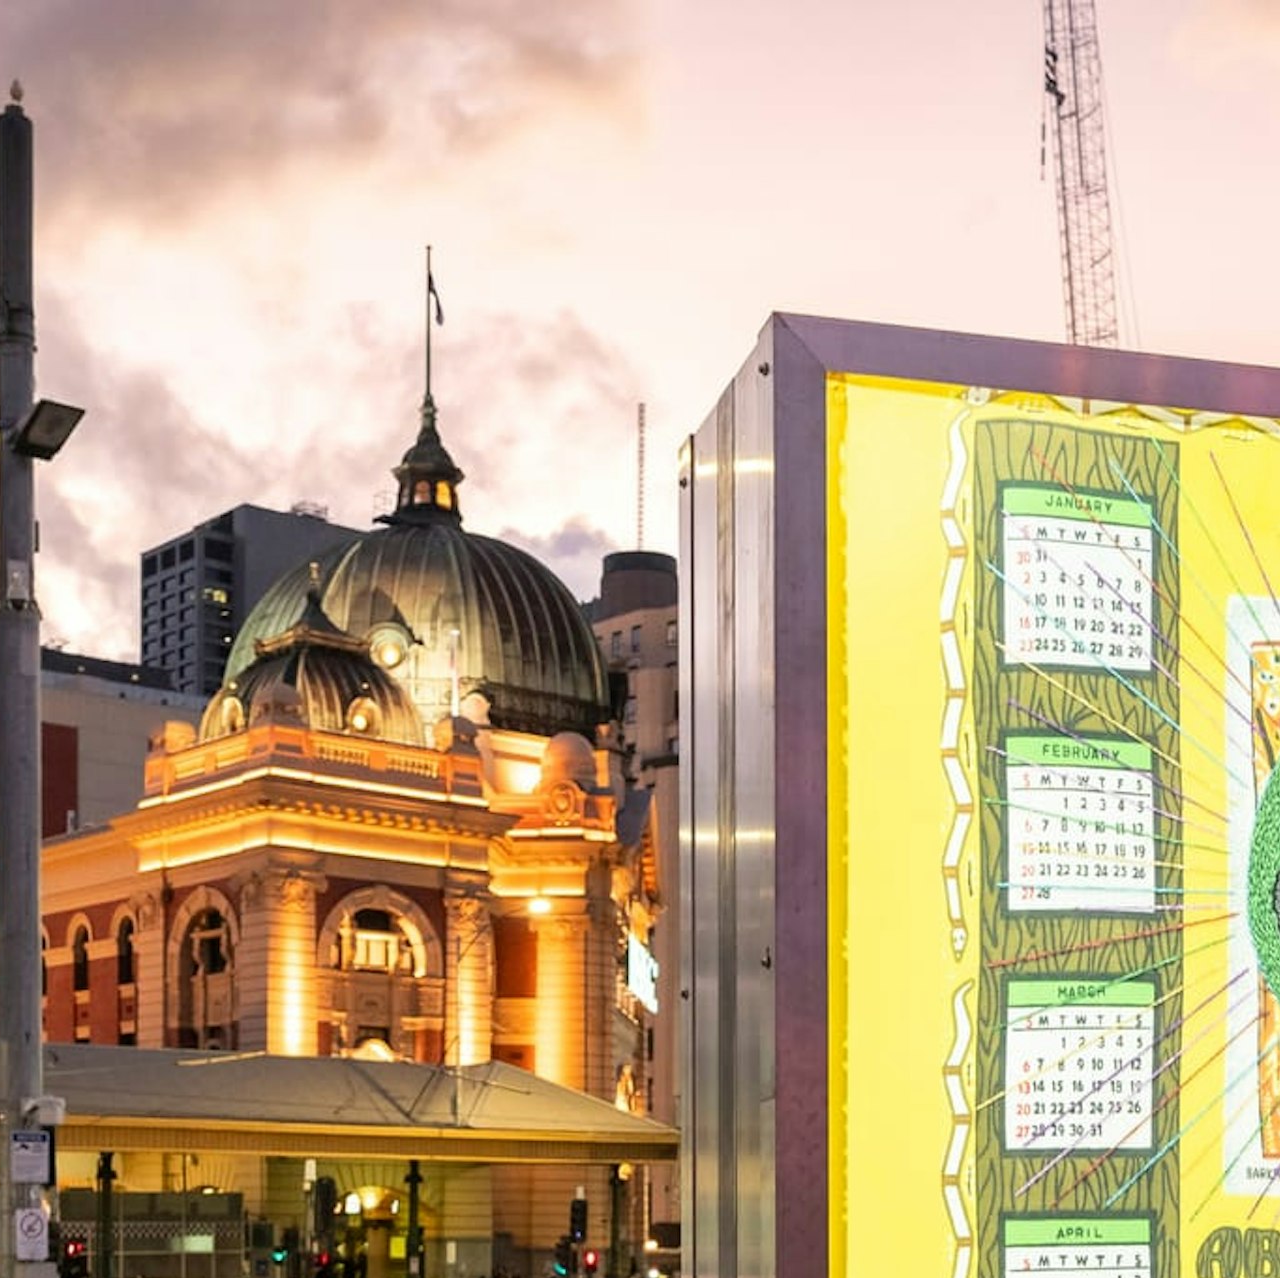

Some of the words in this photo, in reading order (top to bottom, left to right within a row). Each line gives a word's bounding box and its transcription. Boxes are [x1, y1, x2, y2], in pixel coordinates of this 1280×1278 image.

[1045, 496, 1112, 512] JANUARY
[1043, 744, 1120, 760] FEBRUARY
[1058, 985, 1105, 998] MARCH
[1056, 1227, 1102, 1239] APRIL
